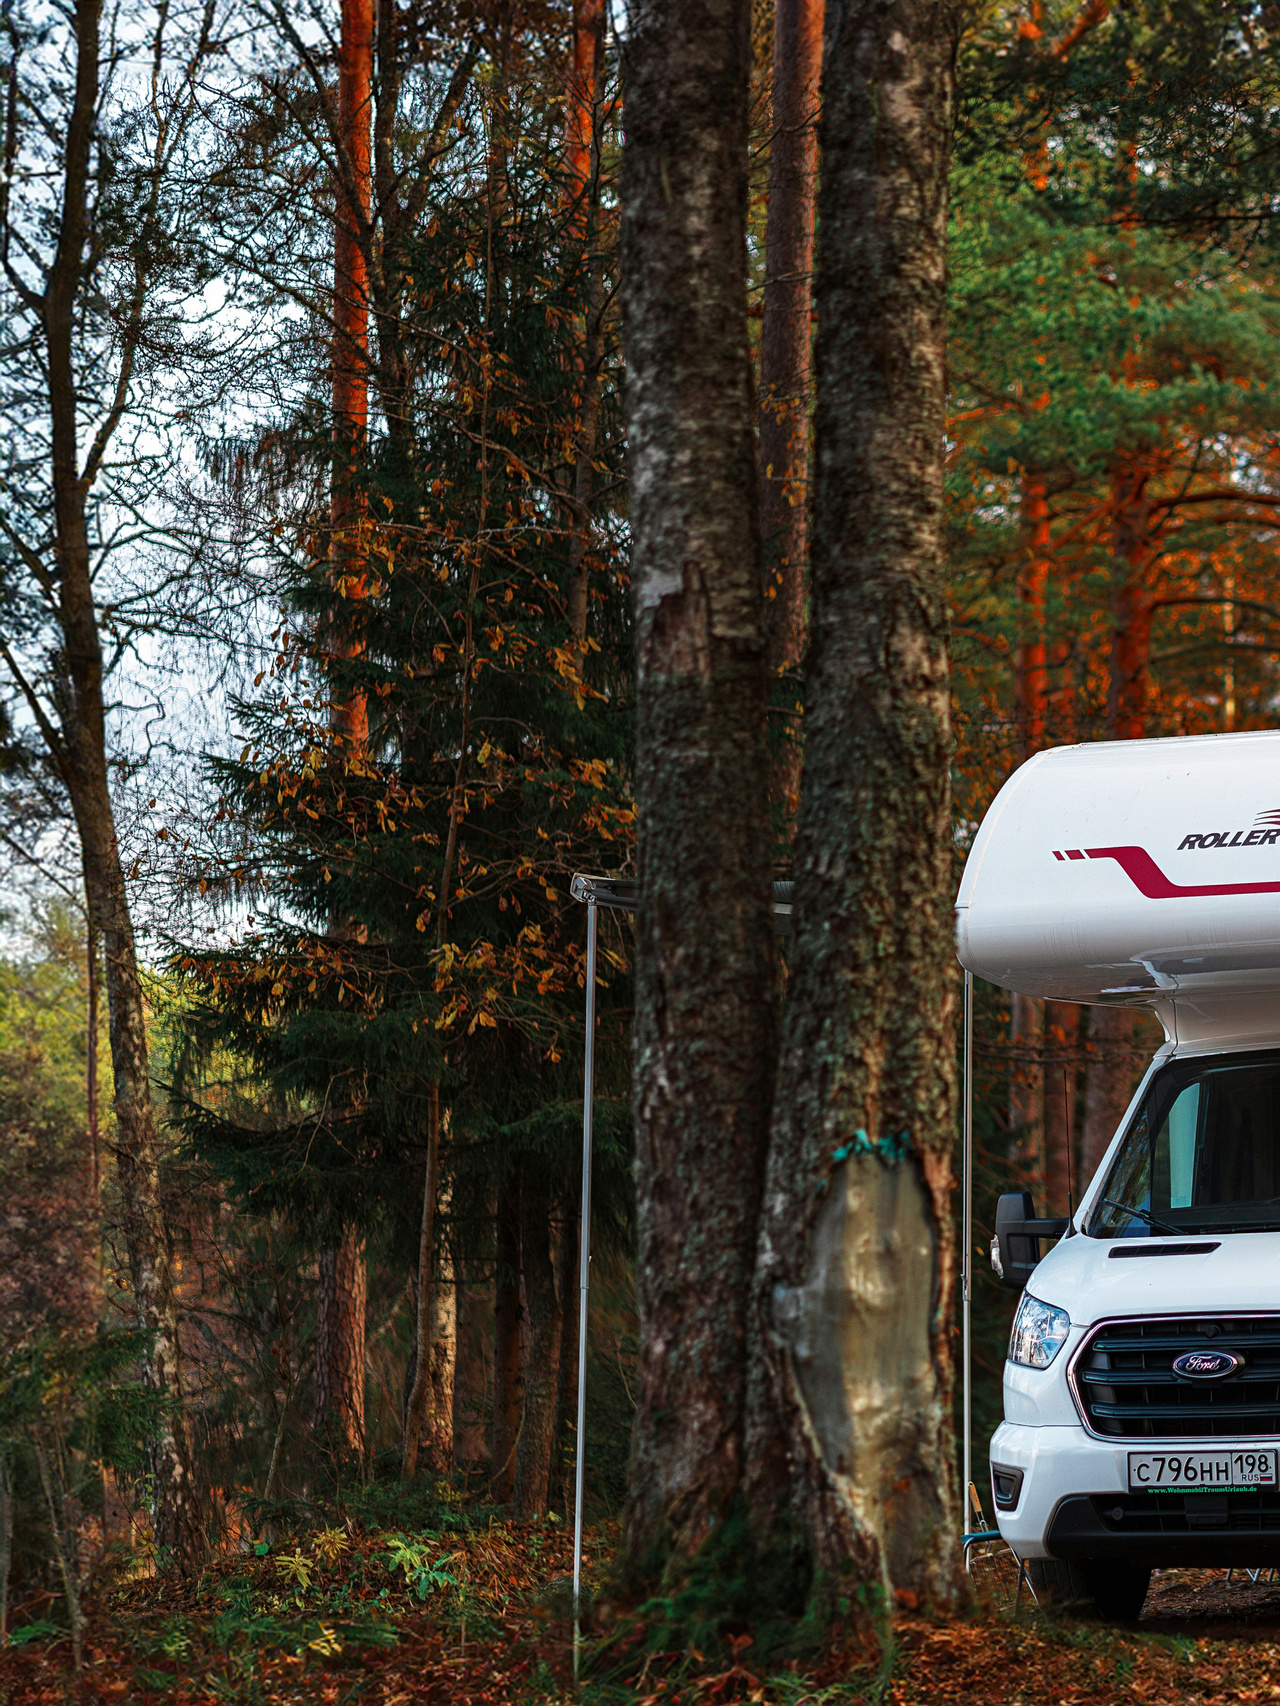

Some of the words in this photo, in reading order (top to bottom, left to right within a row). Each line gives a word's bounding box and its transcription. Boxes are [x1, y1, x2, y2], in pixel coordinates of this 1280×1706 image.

[1185, 1355, 1221, 1371] Ford
[1233, 1454, 1269, 1474] 198
[1241, 1473, 1260, 1482] RUS
[1147, 1485, 1258, 1494] www.WohnmobilTraumUrlaub.de
